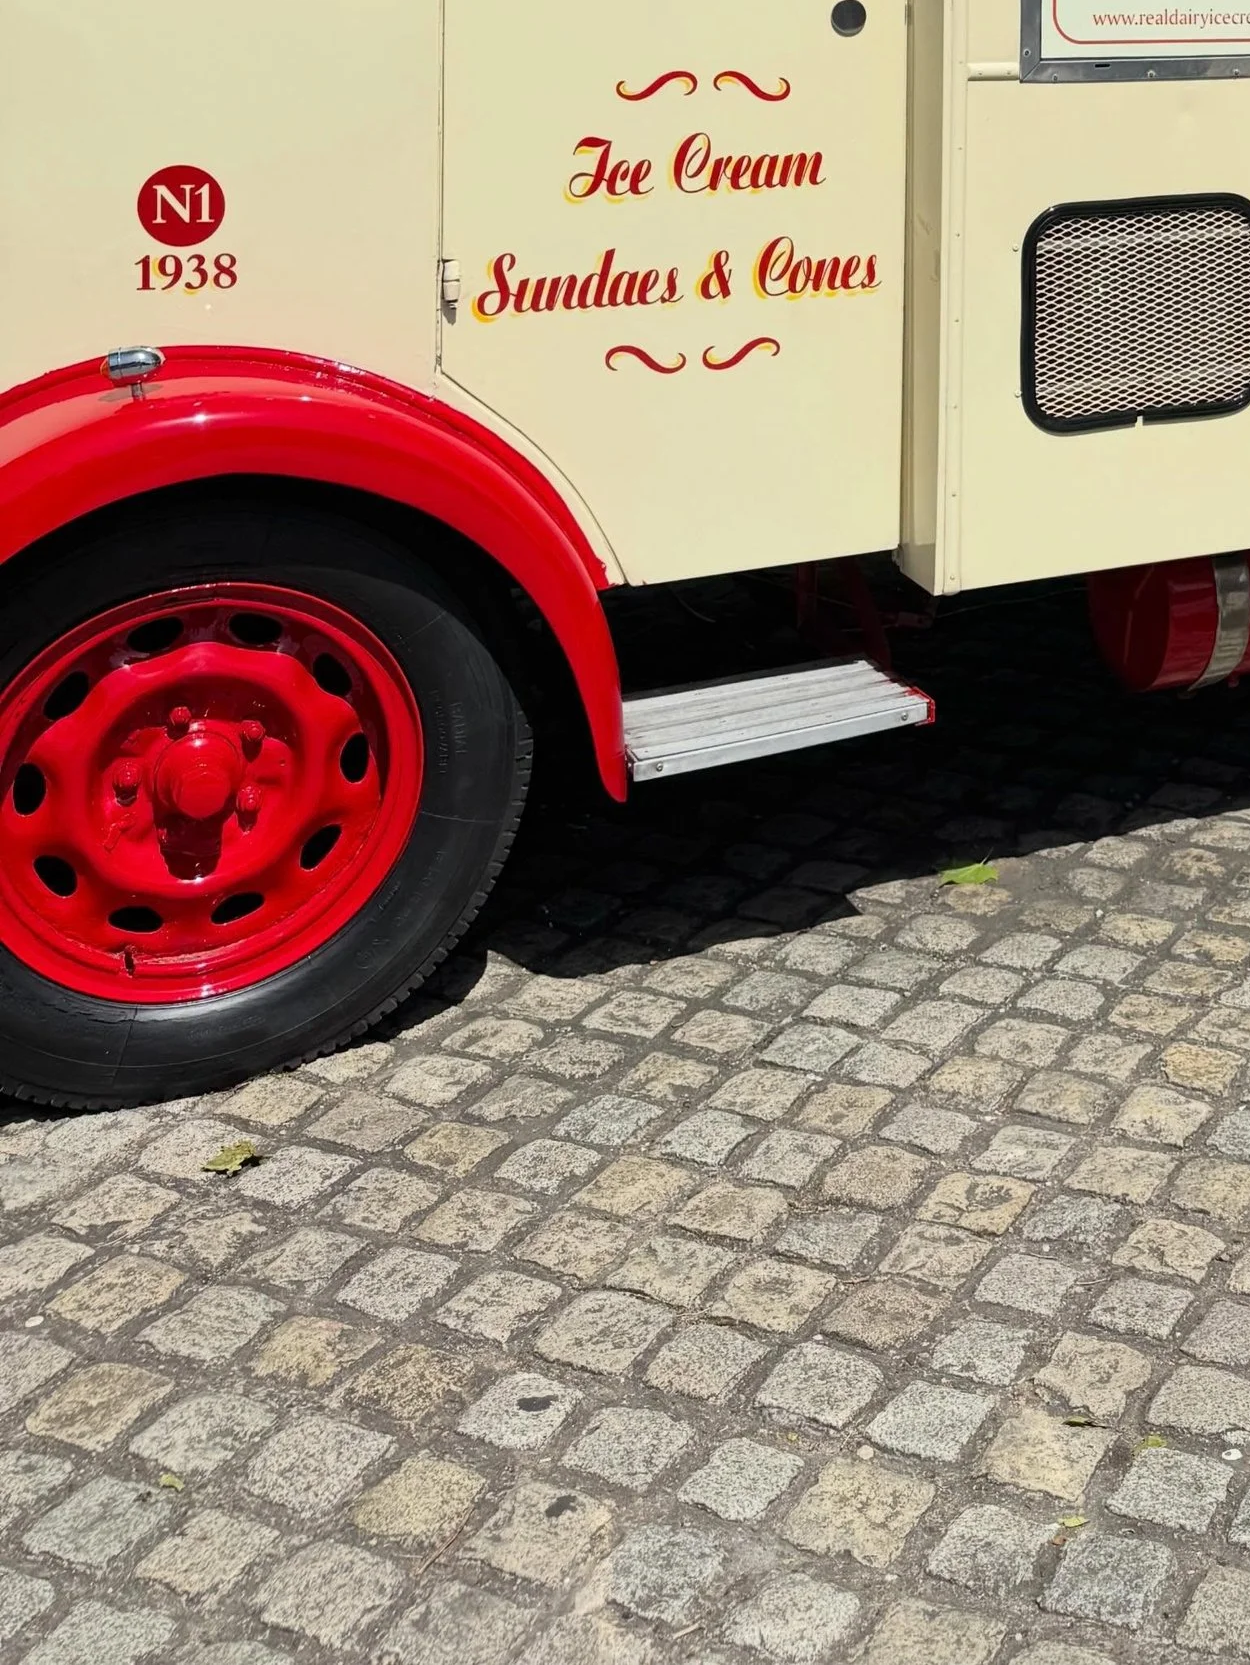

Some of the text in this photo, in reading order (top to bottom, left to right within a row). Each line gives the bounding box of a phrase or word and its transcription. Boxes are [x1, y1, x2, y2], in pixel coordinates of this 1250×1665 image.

[563, 132, 827, 204] Ice Cream
[152, 183, 215, 224] N1
[134, 252, 238, 295] 1938
[471, 236, 883, 323] Sundaes & Cones
